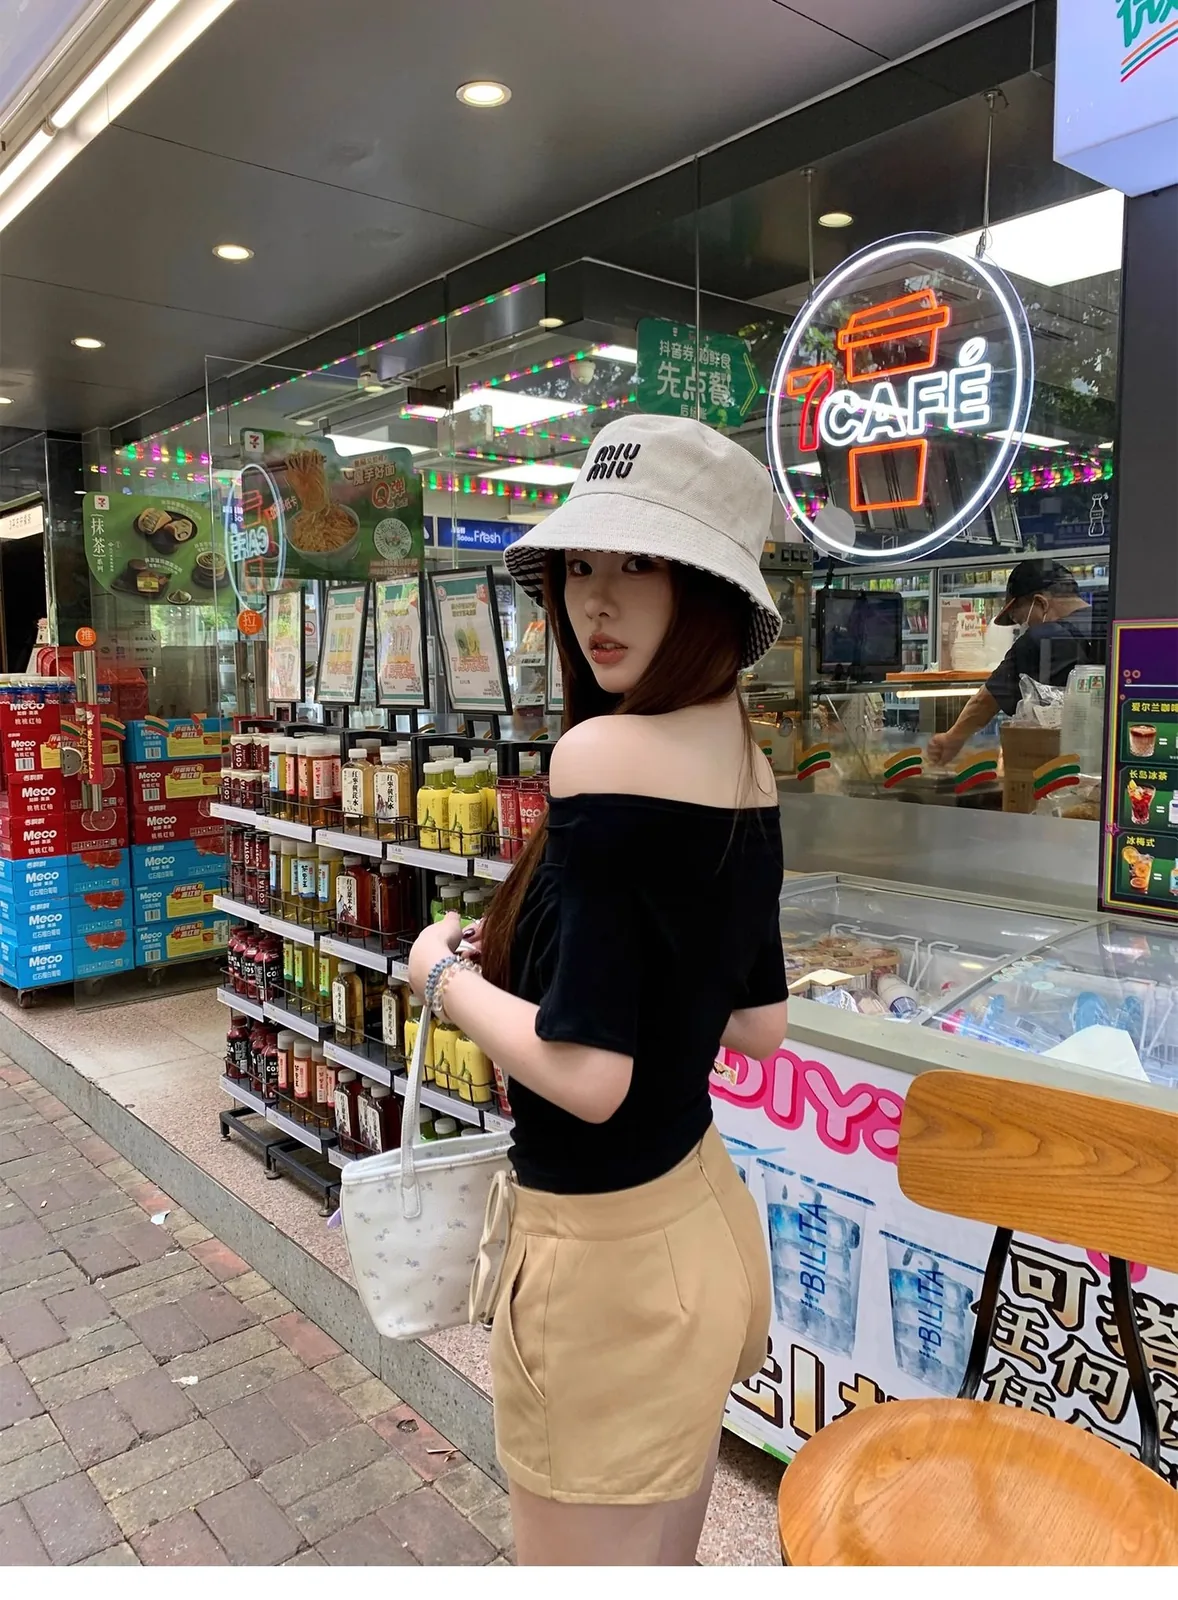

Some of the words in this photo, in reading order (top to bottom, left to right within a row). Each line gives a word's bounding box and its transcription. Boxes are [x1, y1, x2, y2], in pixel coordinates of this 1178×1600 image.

[594, 443, 641, 464] MIU
[586, 461, 633, 482] MIU
[474, 530, 502, 544] Fresh
[22, 787, 56, 798] Meco
[147, 816, 177, 826] Meco
[24, 830, 57, 841] Meco
[145, 856, 175, 866] Meco
[26, 871, 60, 883] Meco
[140, 892, 163, 901] Meco
[29, 914, 62, 926] Meco
[140, 932, 163, 941] Meco
[29, 955, 62, 968] Meco
[709, 1047, 904, 1155] DIY
